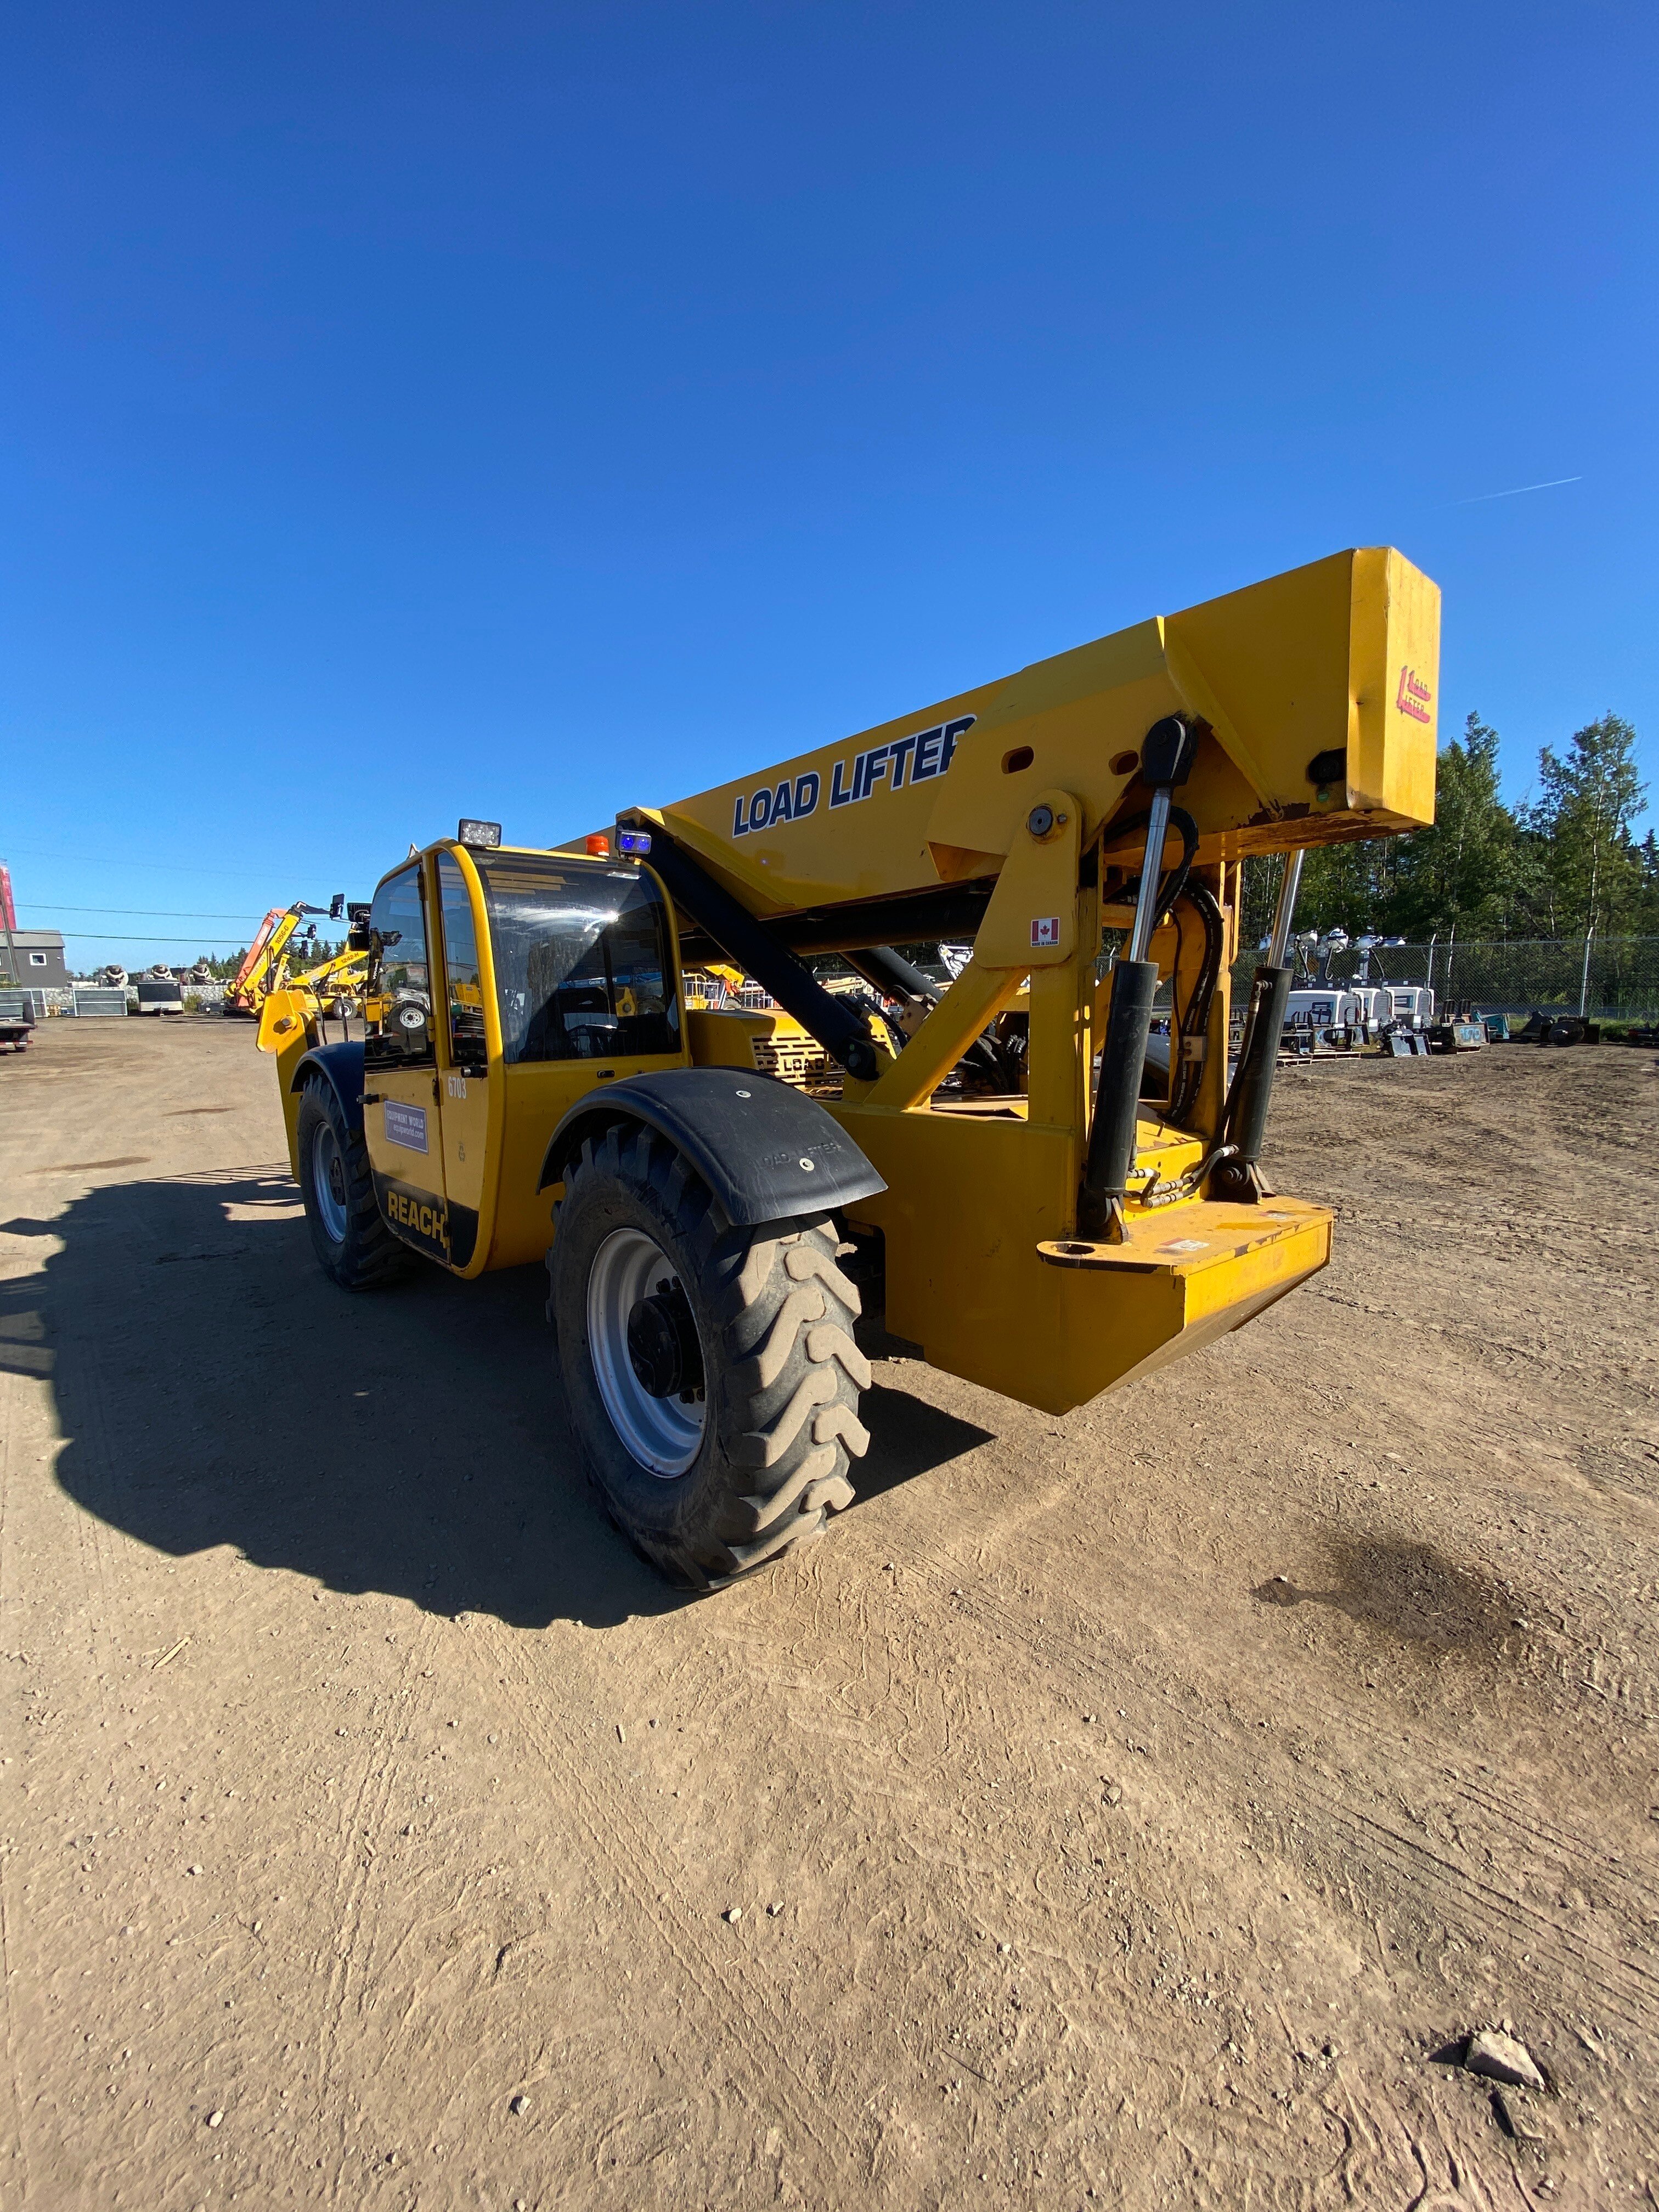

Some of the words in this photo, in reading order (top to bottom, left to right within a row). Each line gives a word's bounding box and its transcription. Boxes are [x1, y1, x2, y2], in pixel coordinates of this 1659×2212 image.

[732, 771, 821, 839] LOAD
[783, 1058, 825, 1071] LOAD
[448, 1076, 466, 1099] 6703
[408, 1115, 424, 1130] WORLD
[388, 1191, 445, 1243] REACH
